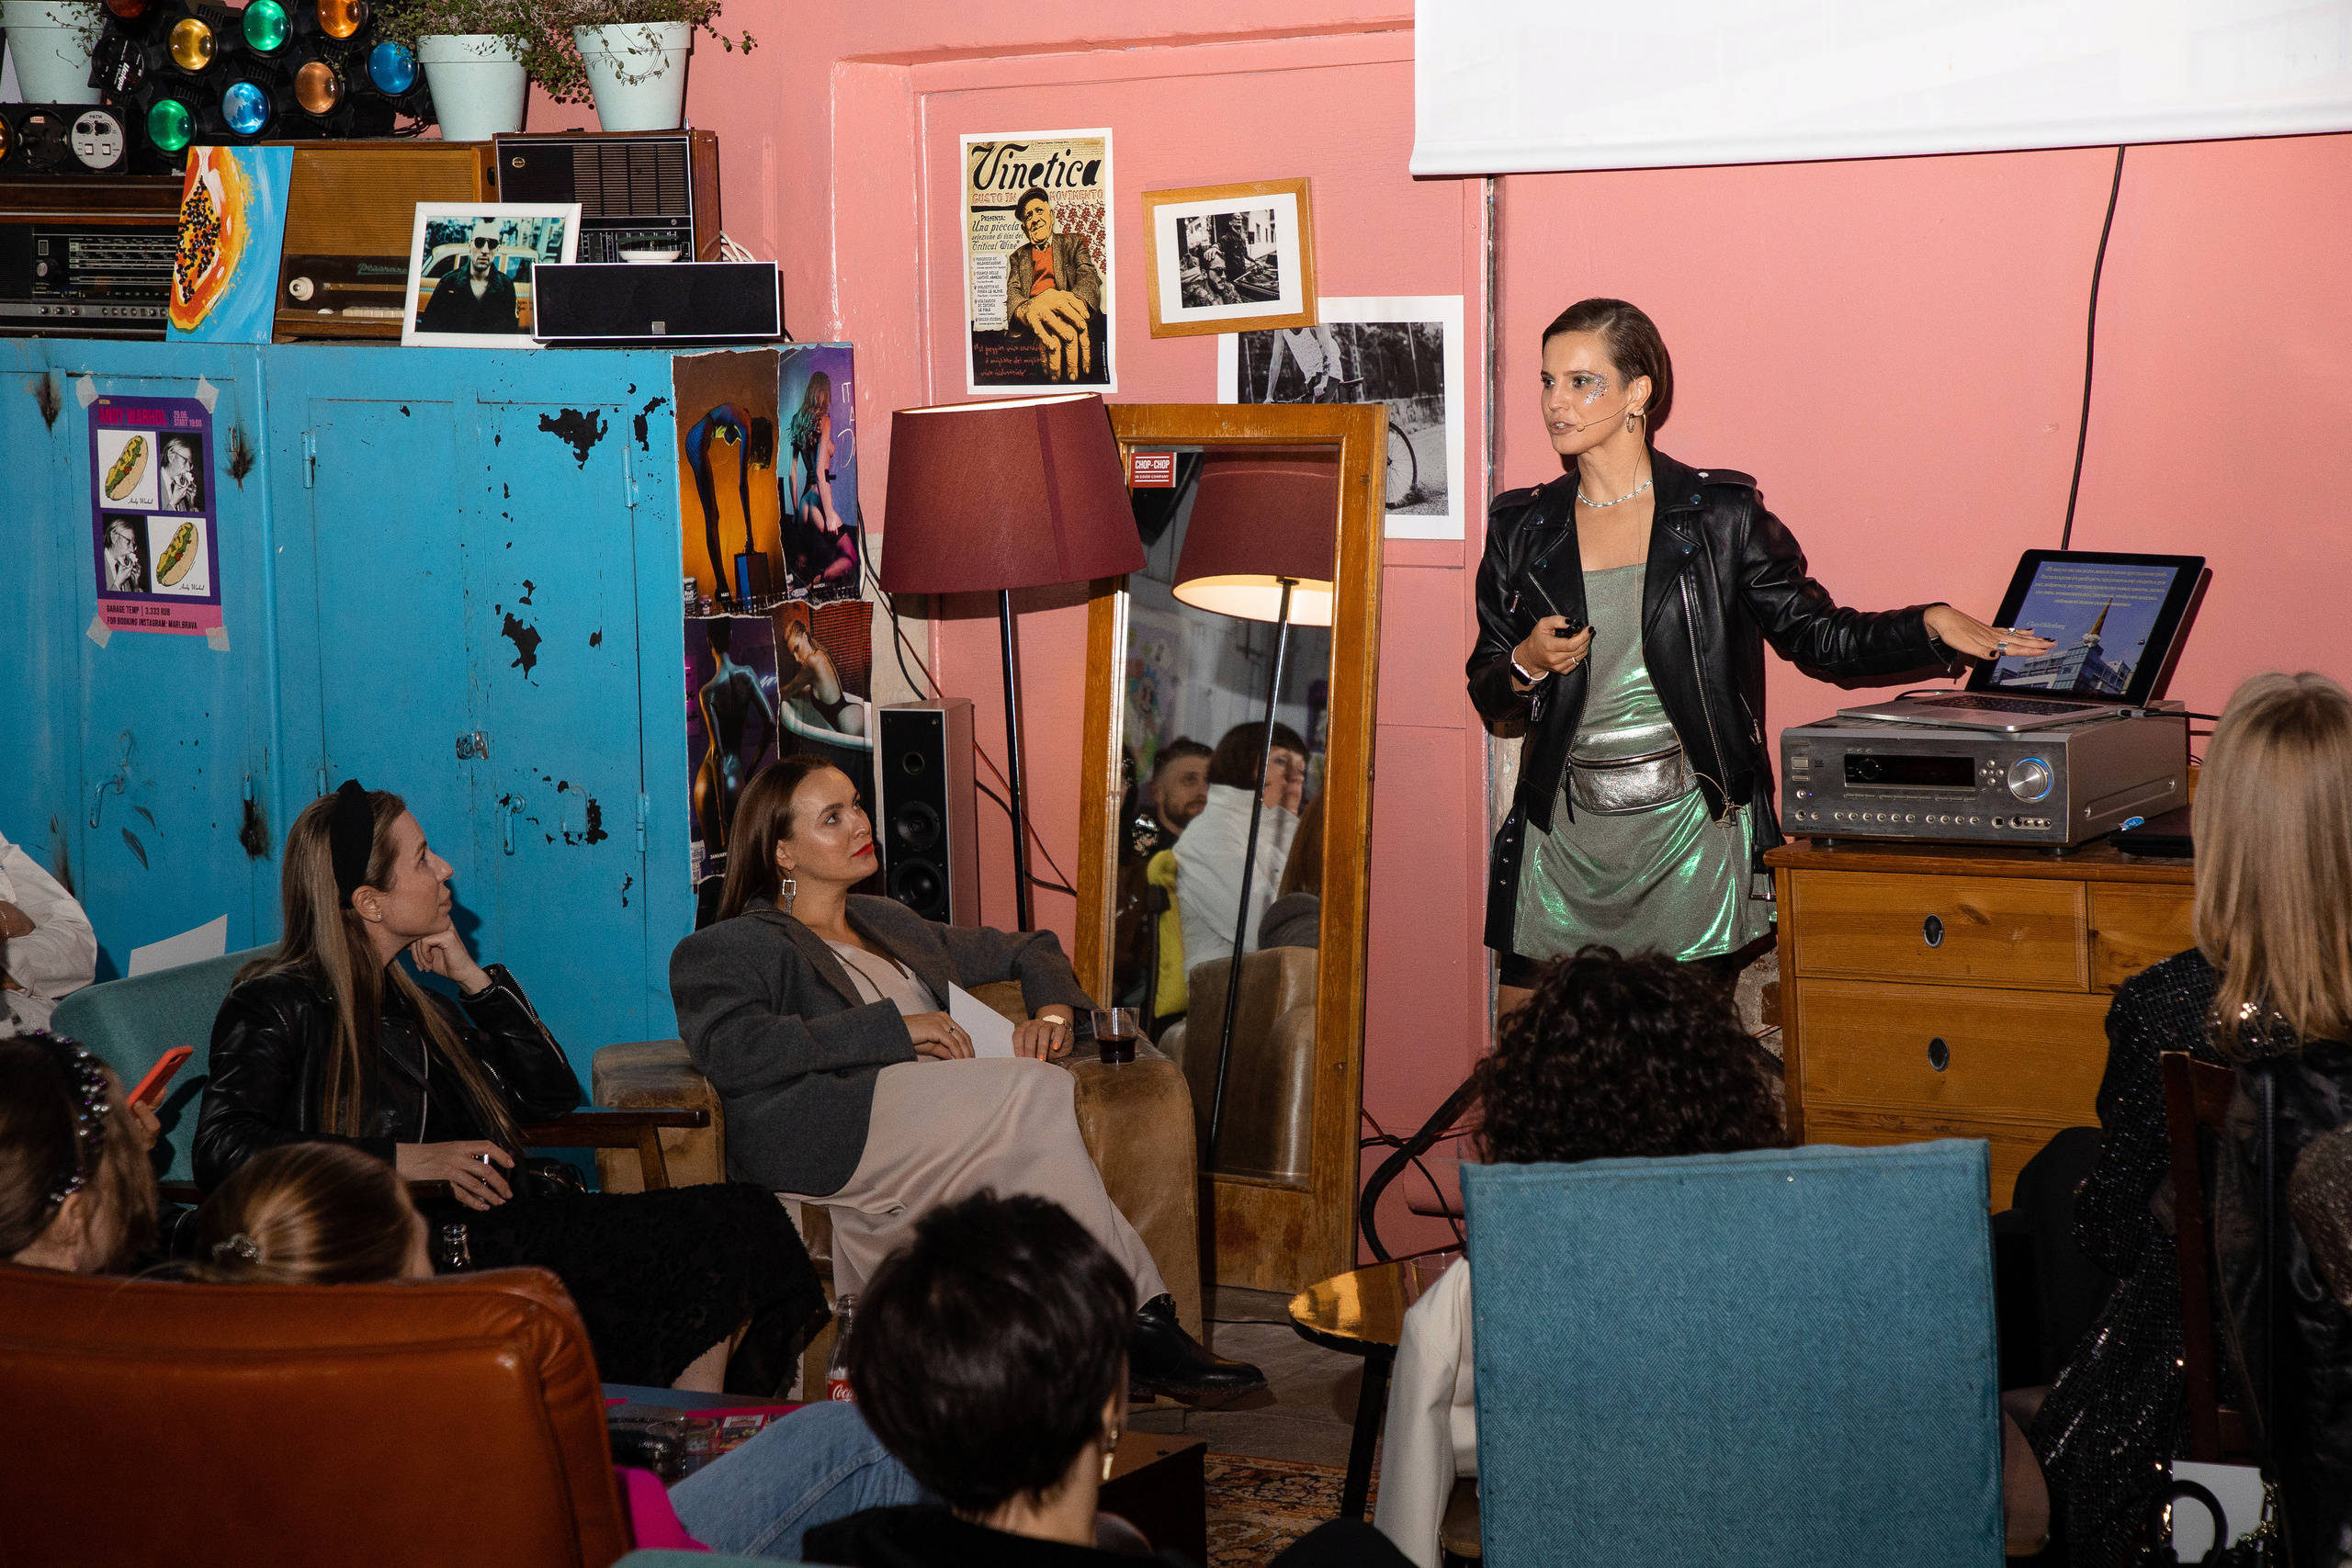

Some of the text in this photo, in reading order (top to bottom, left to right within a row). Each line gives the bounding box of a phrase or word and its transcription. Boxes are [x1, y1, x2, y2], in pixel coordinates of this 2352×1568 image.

[971, 143, 1102, 190] Vinetica
[972, 189, 1103, 203] GUSTO IN MOVIMENTO
[972, 220, 1020, 234] Una piccola
[99, 408, 167, 425] ANDY WARHOL
[1135, 460, 1170, 469] CHOP-CHOP
[145, 607, 160, 615] 3.333
[107, 616, 117, 625] FOR
[118, 617, 138, 626] BOOKING
[139, 619, 167, 627] INSTAGRAM:
